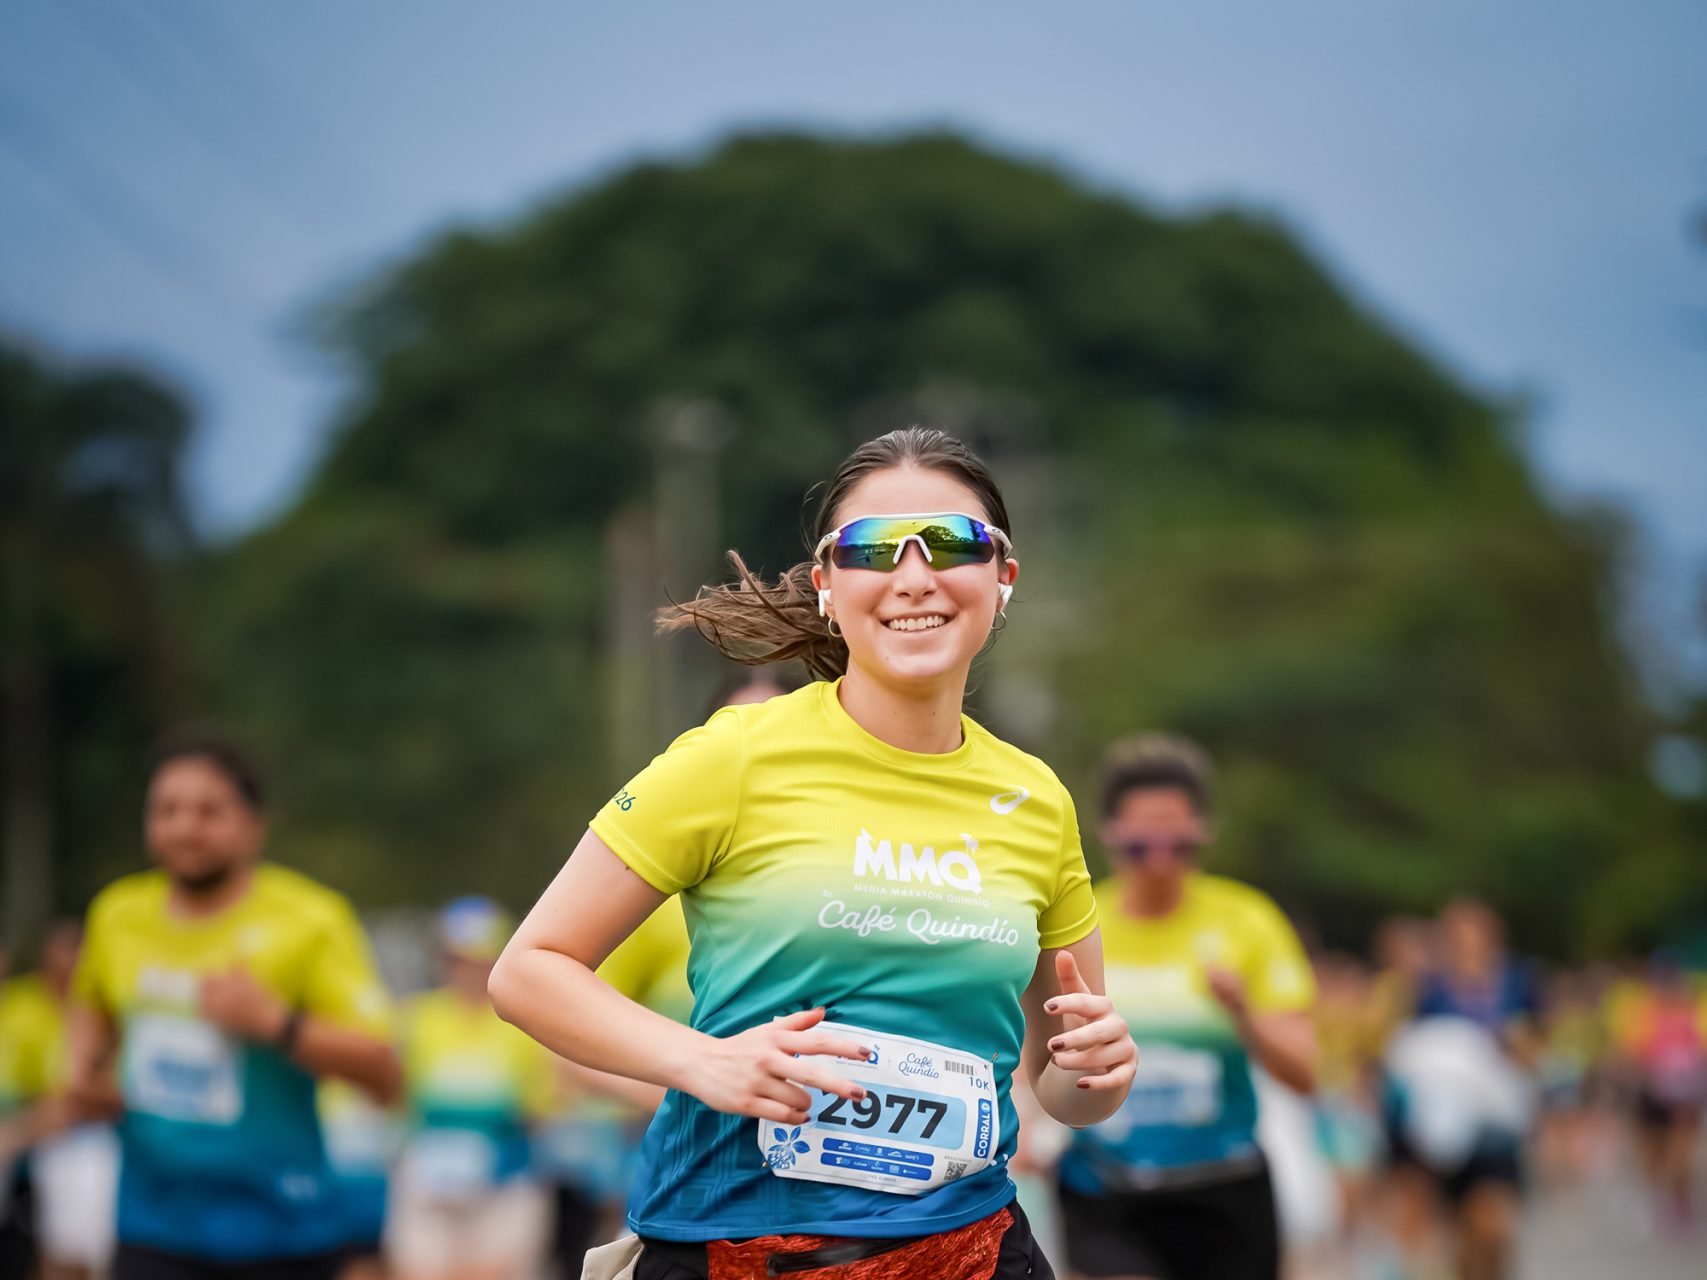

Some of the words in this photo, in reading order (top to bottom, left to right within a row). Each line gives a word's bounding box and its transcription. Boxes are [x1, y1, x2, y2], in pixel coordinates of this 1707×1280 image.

[853, 832, 983, 894] MMQ
[818, 899, 897, 937] Café
[906, 908, 1019, 946] Quindío
[898, 1061, 940, 1079] Quindío
[906, 1053, 933, 1068] Café
[969, 1076, 990, 1091] 10K
[818, 1089, 948, 1139] 2977
[981, 1103, 991, 1113] D
[977, 1113, 991, 1158] CORRAL
